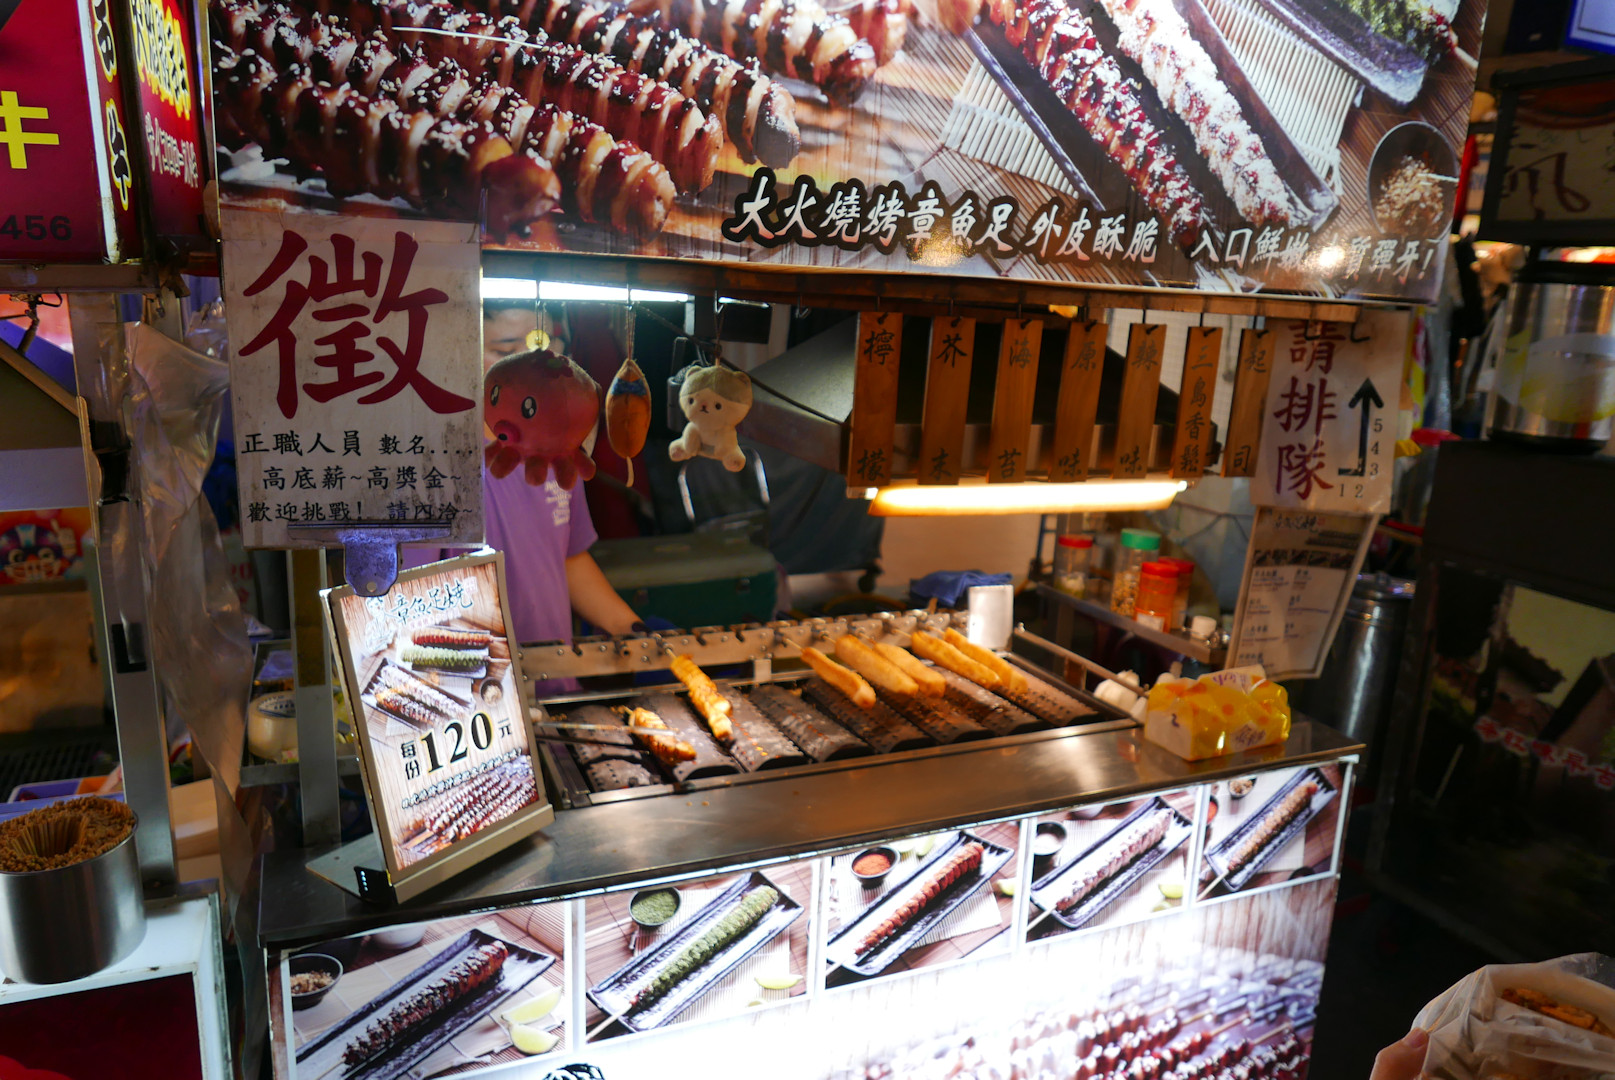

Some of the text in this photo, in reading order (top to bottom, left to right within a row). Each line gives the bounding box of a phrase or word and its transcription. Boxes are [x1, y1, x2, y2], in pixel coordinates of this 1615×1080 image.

[729, 176, 1014, 253] 大火燒烤章魚足
[1024, 204, 1159, 264] 外皮酥脆
[1316, 233, 1434, 285] 質彈牙!
[239, 229, 476, 420] 徵
[855, 329, 896, 481] 檸檬
[998, 340, 1032, 479] 海苔
[1059, 341, 1098, 476] 原味
[1273, 322, 1345, 500] 請排隊
[1373, 418, 1384, 433] 5
[240, 430, 362, 457] 正職人員
[1369, 463, 1379, 476] 3
[1370, 441, 1380, 455] 4
[248, 501, 363, 523] 歡迎挑戰!
[1339, 484, 1364, 498] 1 2
[400, 740, 421, 780] 每份
[420, 711, 494, 774] 120
[497, 718, 511, 739] 元
